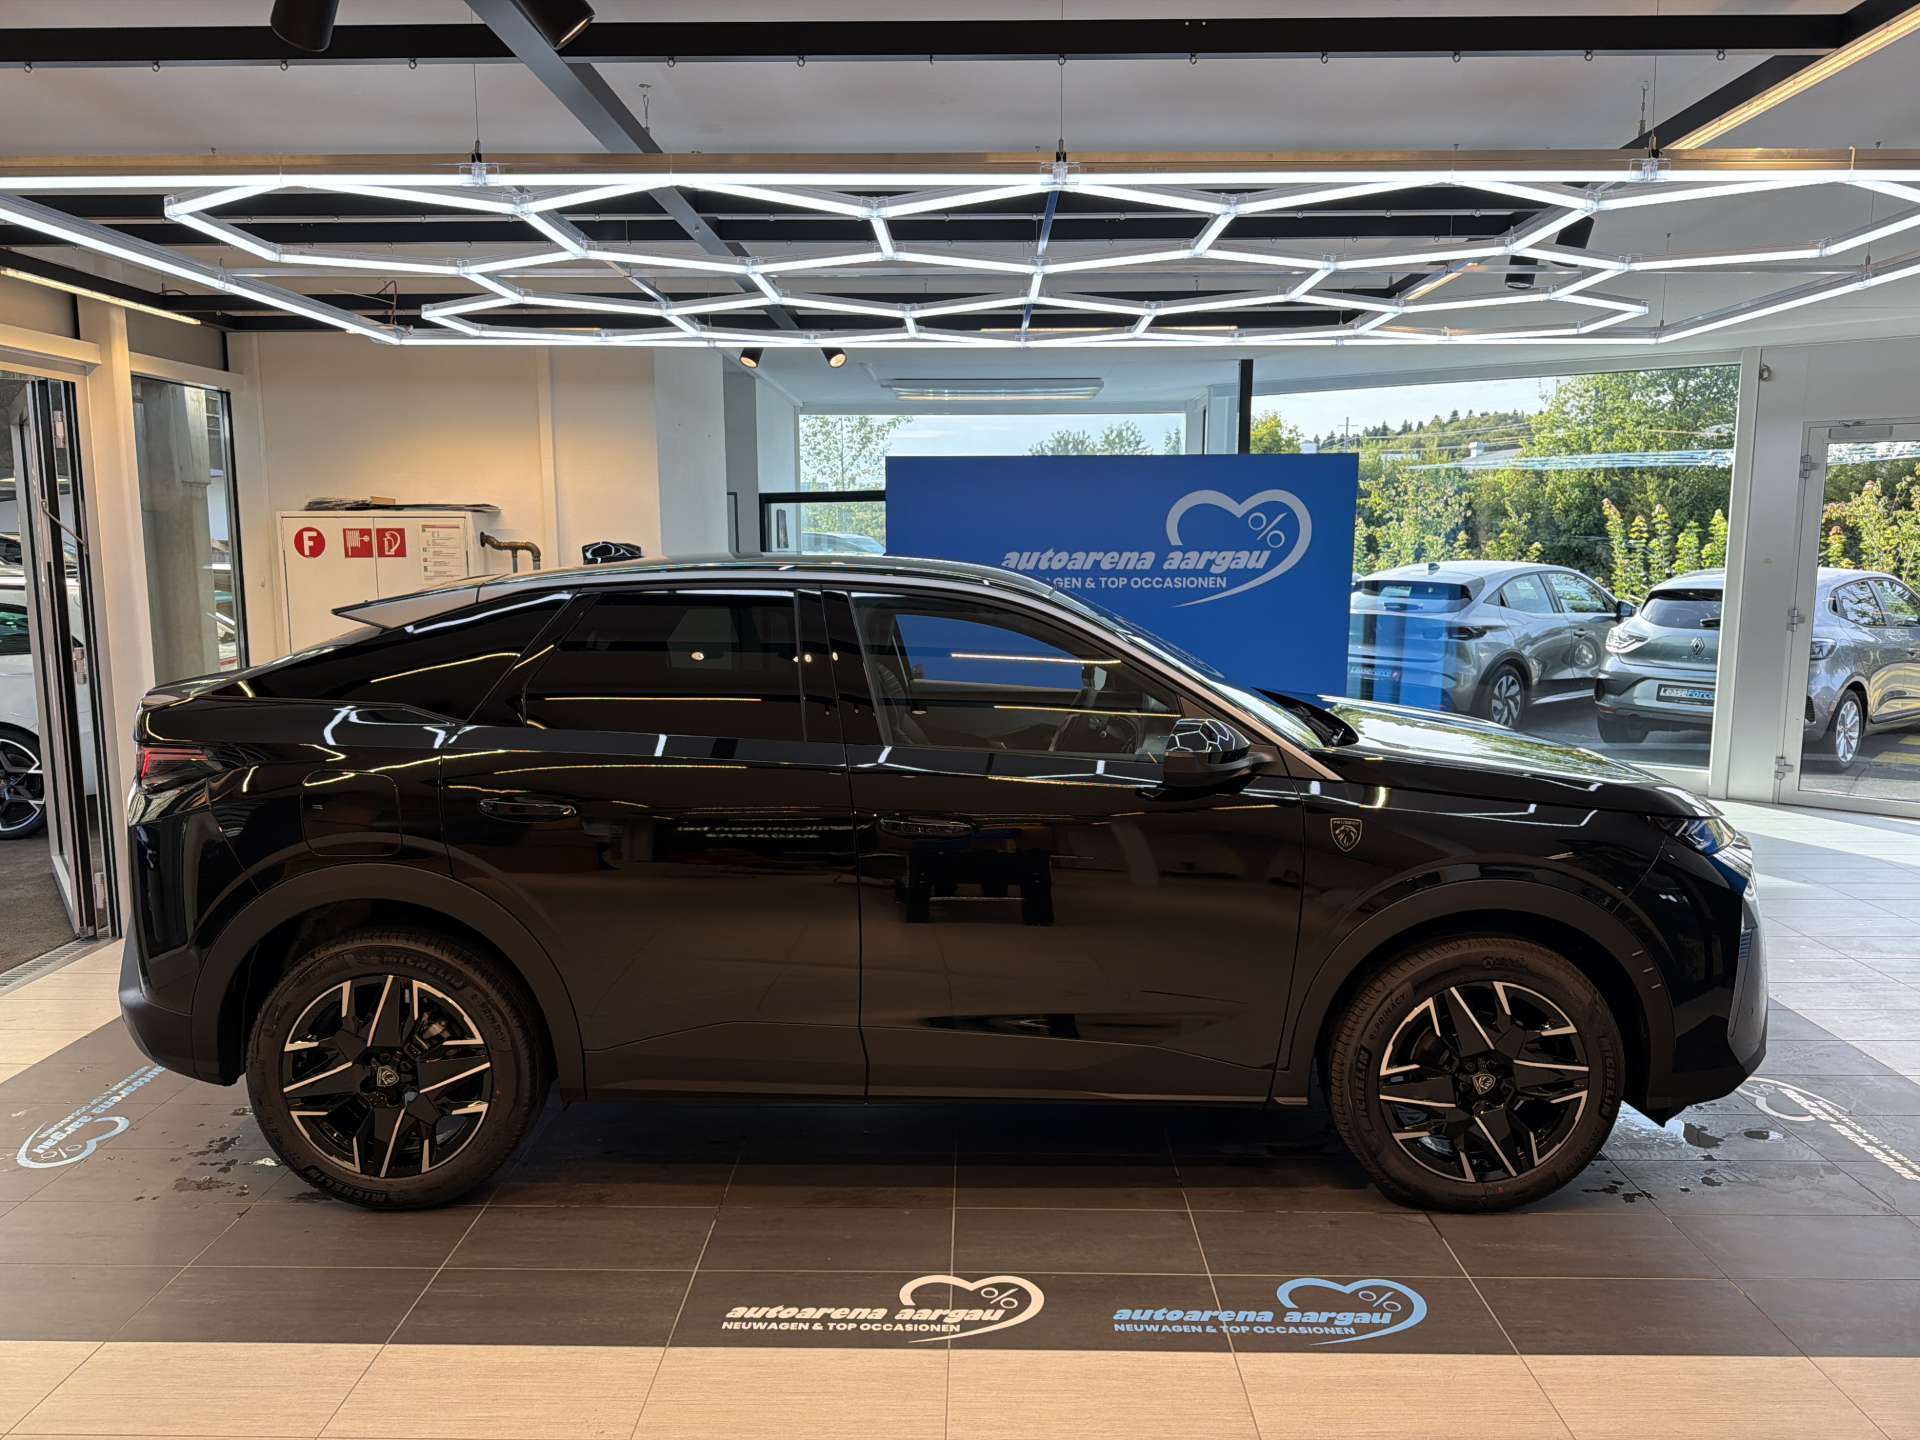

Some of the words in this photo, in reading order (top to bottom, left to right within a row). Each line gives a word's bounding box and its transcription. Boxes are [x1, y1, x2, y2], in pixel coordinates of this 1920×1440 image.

[302, 531, 318, 557] F
[1001, 548, 1156, 571] autoarena
[1163, 550, 1271, 573] aargau
[1099, 577, 1127, 590] TOP
[1130, 577, 1228, 590] OCCASIONEN
[725, 1304, 888, 1320] autoarena
[894, 1308, 1006, 1324] aargau
[1113, 1307, 1275, 1323] autoarena
[1283, 1310, 1393, 1326] aargau
[721, 1321, 809, 1331] NEUWAGEN
[812, 1322, 823, 1331] &
[827, 1322, 857, 1331] TOP
[859, 1323, 961, 1333] OCCASIONEN
[1113, 1323, 1203, 1333] NEUWAGEN
[1205, 1324, 1217, 1333] &
[1220, 1325, 1250, 1334] TOP
[1253, 1325, 1357, 1335] OCCASIONEN
